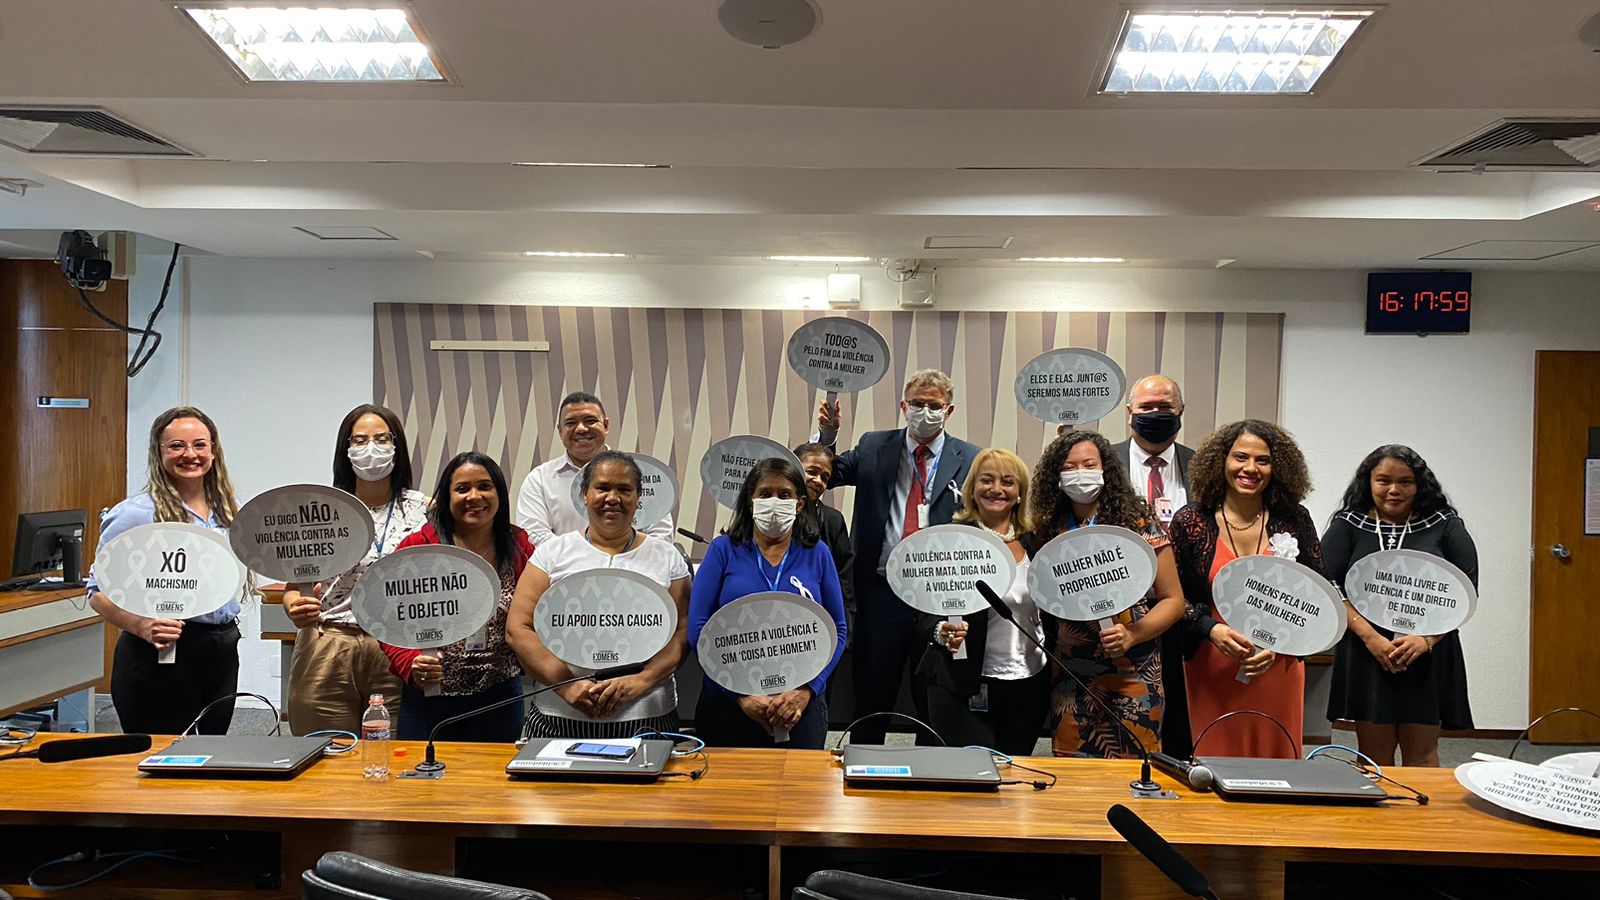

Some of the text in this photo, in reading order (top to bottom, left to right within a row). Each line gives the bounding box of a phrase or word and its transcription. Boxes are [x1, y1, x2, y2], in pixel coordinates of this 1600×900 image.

[825, 334, 858, 348] TOD@S
[804, 345, 874, 363] PELO FIM DA VIOLÊNCIA
[809, 359, 865, 374] CONTRA A MULHER
[1030, 372, 1107, 384] ELES E ELAS. JUNT@S
[1028, 387, 1110, 398] SEREMOS MAIS FORTES
[722, 454, 734, 464] NÃO
[736, 456, 756, 467] FECHE
[652, 475, 661, 484] DA
[724, 468, 747, 479] PARA A
[722, 481, 742, 491] CONT
[264, 514, 275, 526] EU
[277, 514, 298, 525] DIGO
[299, 502, 331, 524] NÃO
[255, 527, 349, 544] VIOLÊNCIA CONTRA AS
[276, 542, 334, 559] MULHERES
[905, 550, 991, 562] A VIOLÊNCIA CONTRA A
[160, 548, 186, 573] XÔ
[1052, 545, 1124, 578] MULHER NÃO É
[902, 564, 996, 578] MULHER MATA. DIGA NÃO
[146, 578, 198, 590] MACHISMO!
[386, 573, 467, 597] MULHER NÃO
[932, 579, 975, 592] VIOLÊNCIA!
[1059, 566, 1130, 596] PROPRIEDADE!
[1376, 571, 1449, 593] UMA VIDA LIVRE DE
[1246, 578, 1320, 617] HOMENS PELA VIDA
[1364, 582, 1456, 609] VIOLÊNCIA É UM DIREITO
[397, 600, 459, 620] É OBJETO!
[1246, 595, 1306, 628] DAS MULHERES
[1388, 602, 1426, 616] DE TODAS
[552, 614, 662, 626] EU APOIO ESSA CAUSA!
[715, 621, 818, 648] COMBATER A VIOLÊNCIA É
[722, 652, 737, 664] SIM
[768, 646, 778, 657] DE
[1527, 790, 1547, 799] SER
